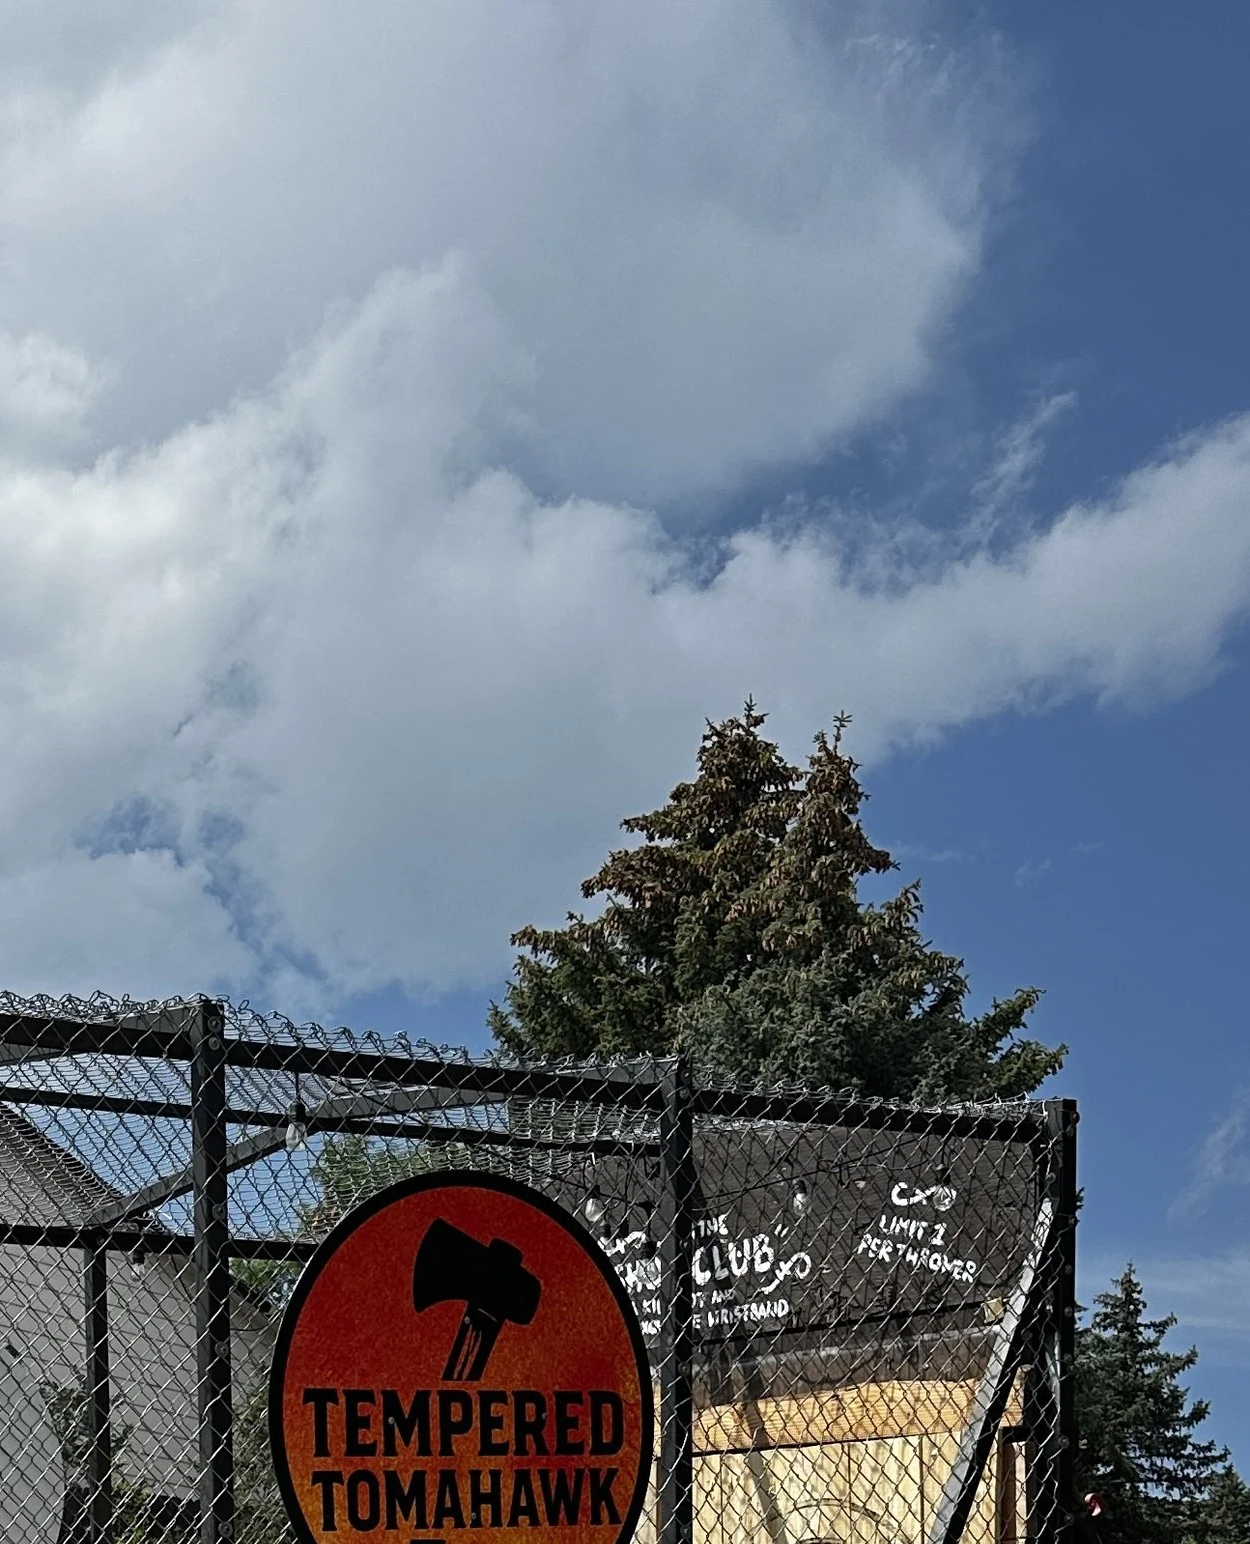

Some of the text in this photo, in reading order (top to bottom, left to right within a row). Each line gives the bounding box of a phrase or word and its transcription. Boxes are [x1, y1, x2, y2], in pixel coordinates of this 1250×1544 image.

[879, 1214, 929, 1241] LIMIT
[857, 1233, 977, 1284] PER THROWER
[707, 1298, 790, 1329] WRISTBAND
[301, 1386, 625, 1459] TEMPERED
[310, 1466, 625, 1533] TOMAHAWK
